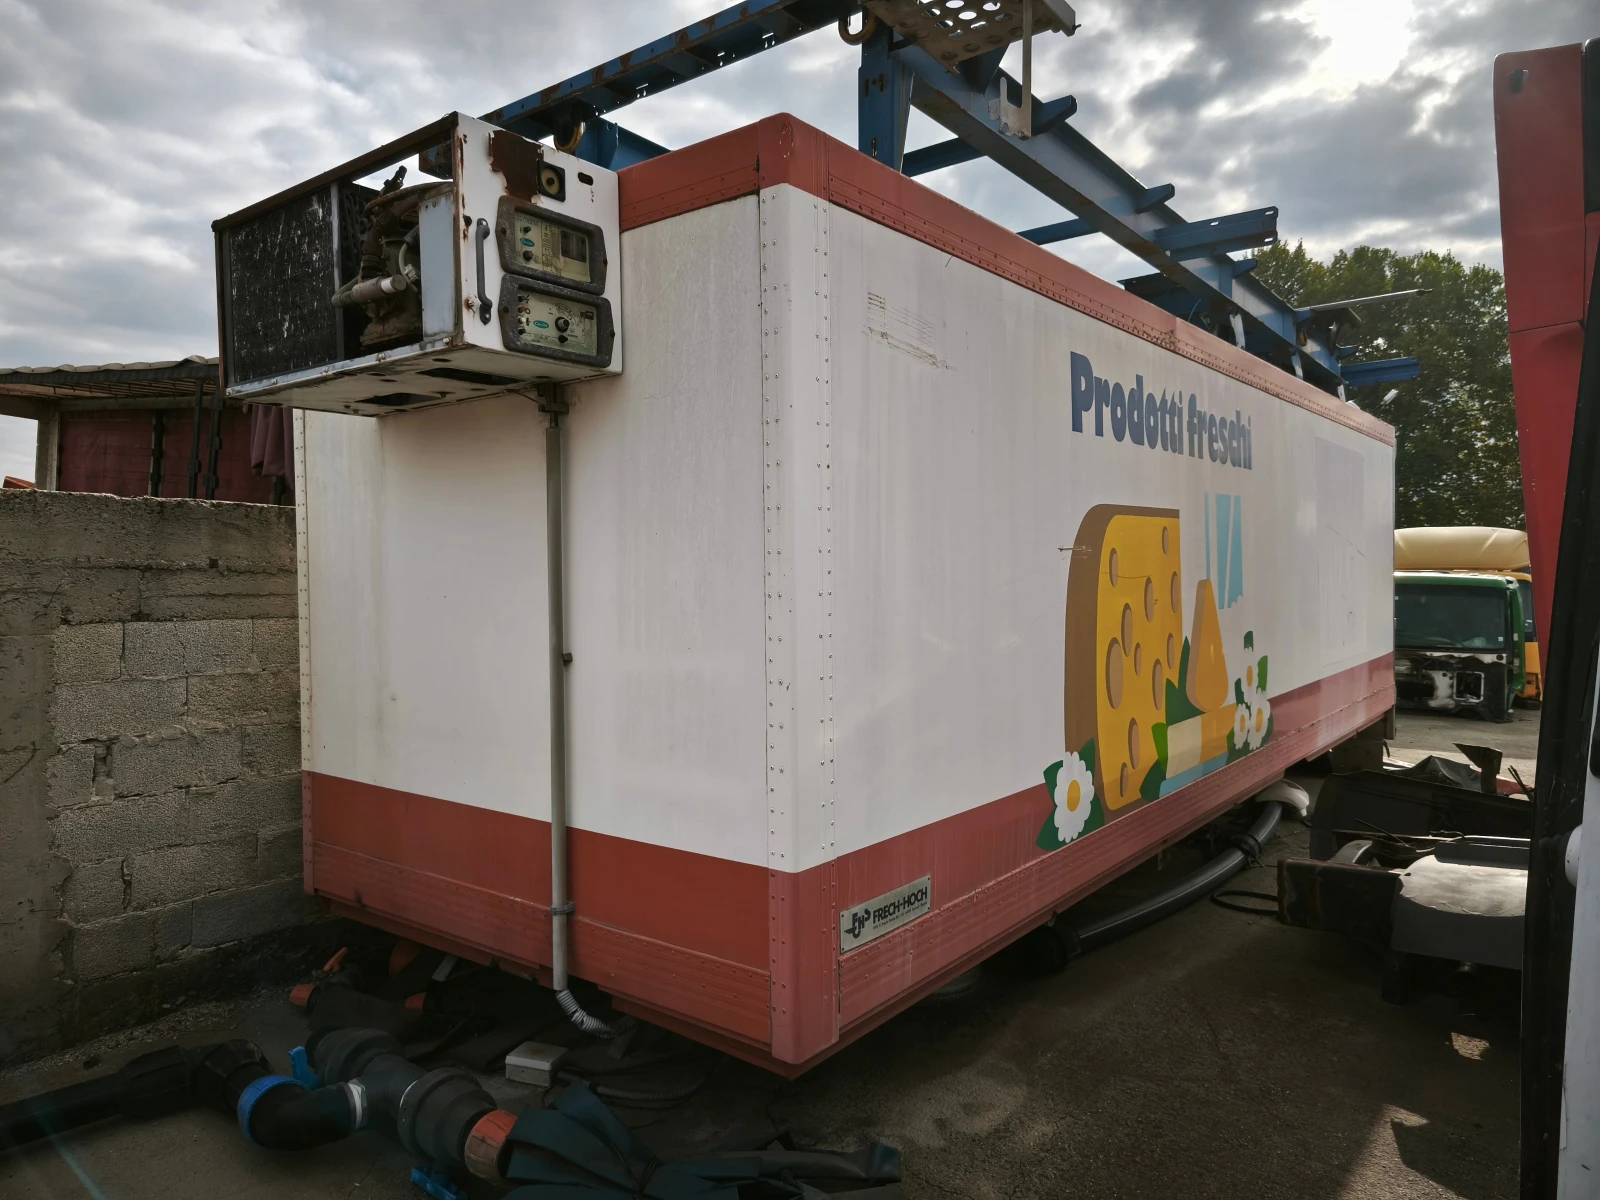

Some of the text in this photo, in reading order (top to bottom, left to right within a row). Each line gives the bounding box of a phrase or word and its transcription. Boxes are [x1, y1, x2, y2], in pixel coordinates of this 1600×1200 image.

[1070, 351, 1252, 470] Prodotti freschi
[873, 886, 928, 925] FRECH-HOCH
